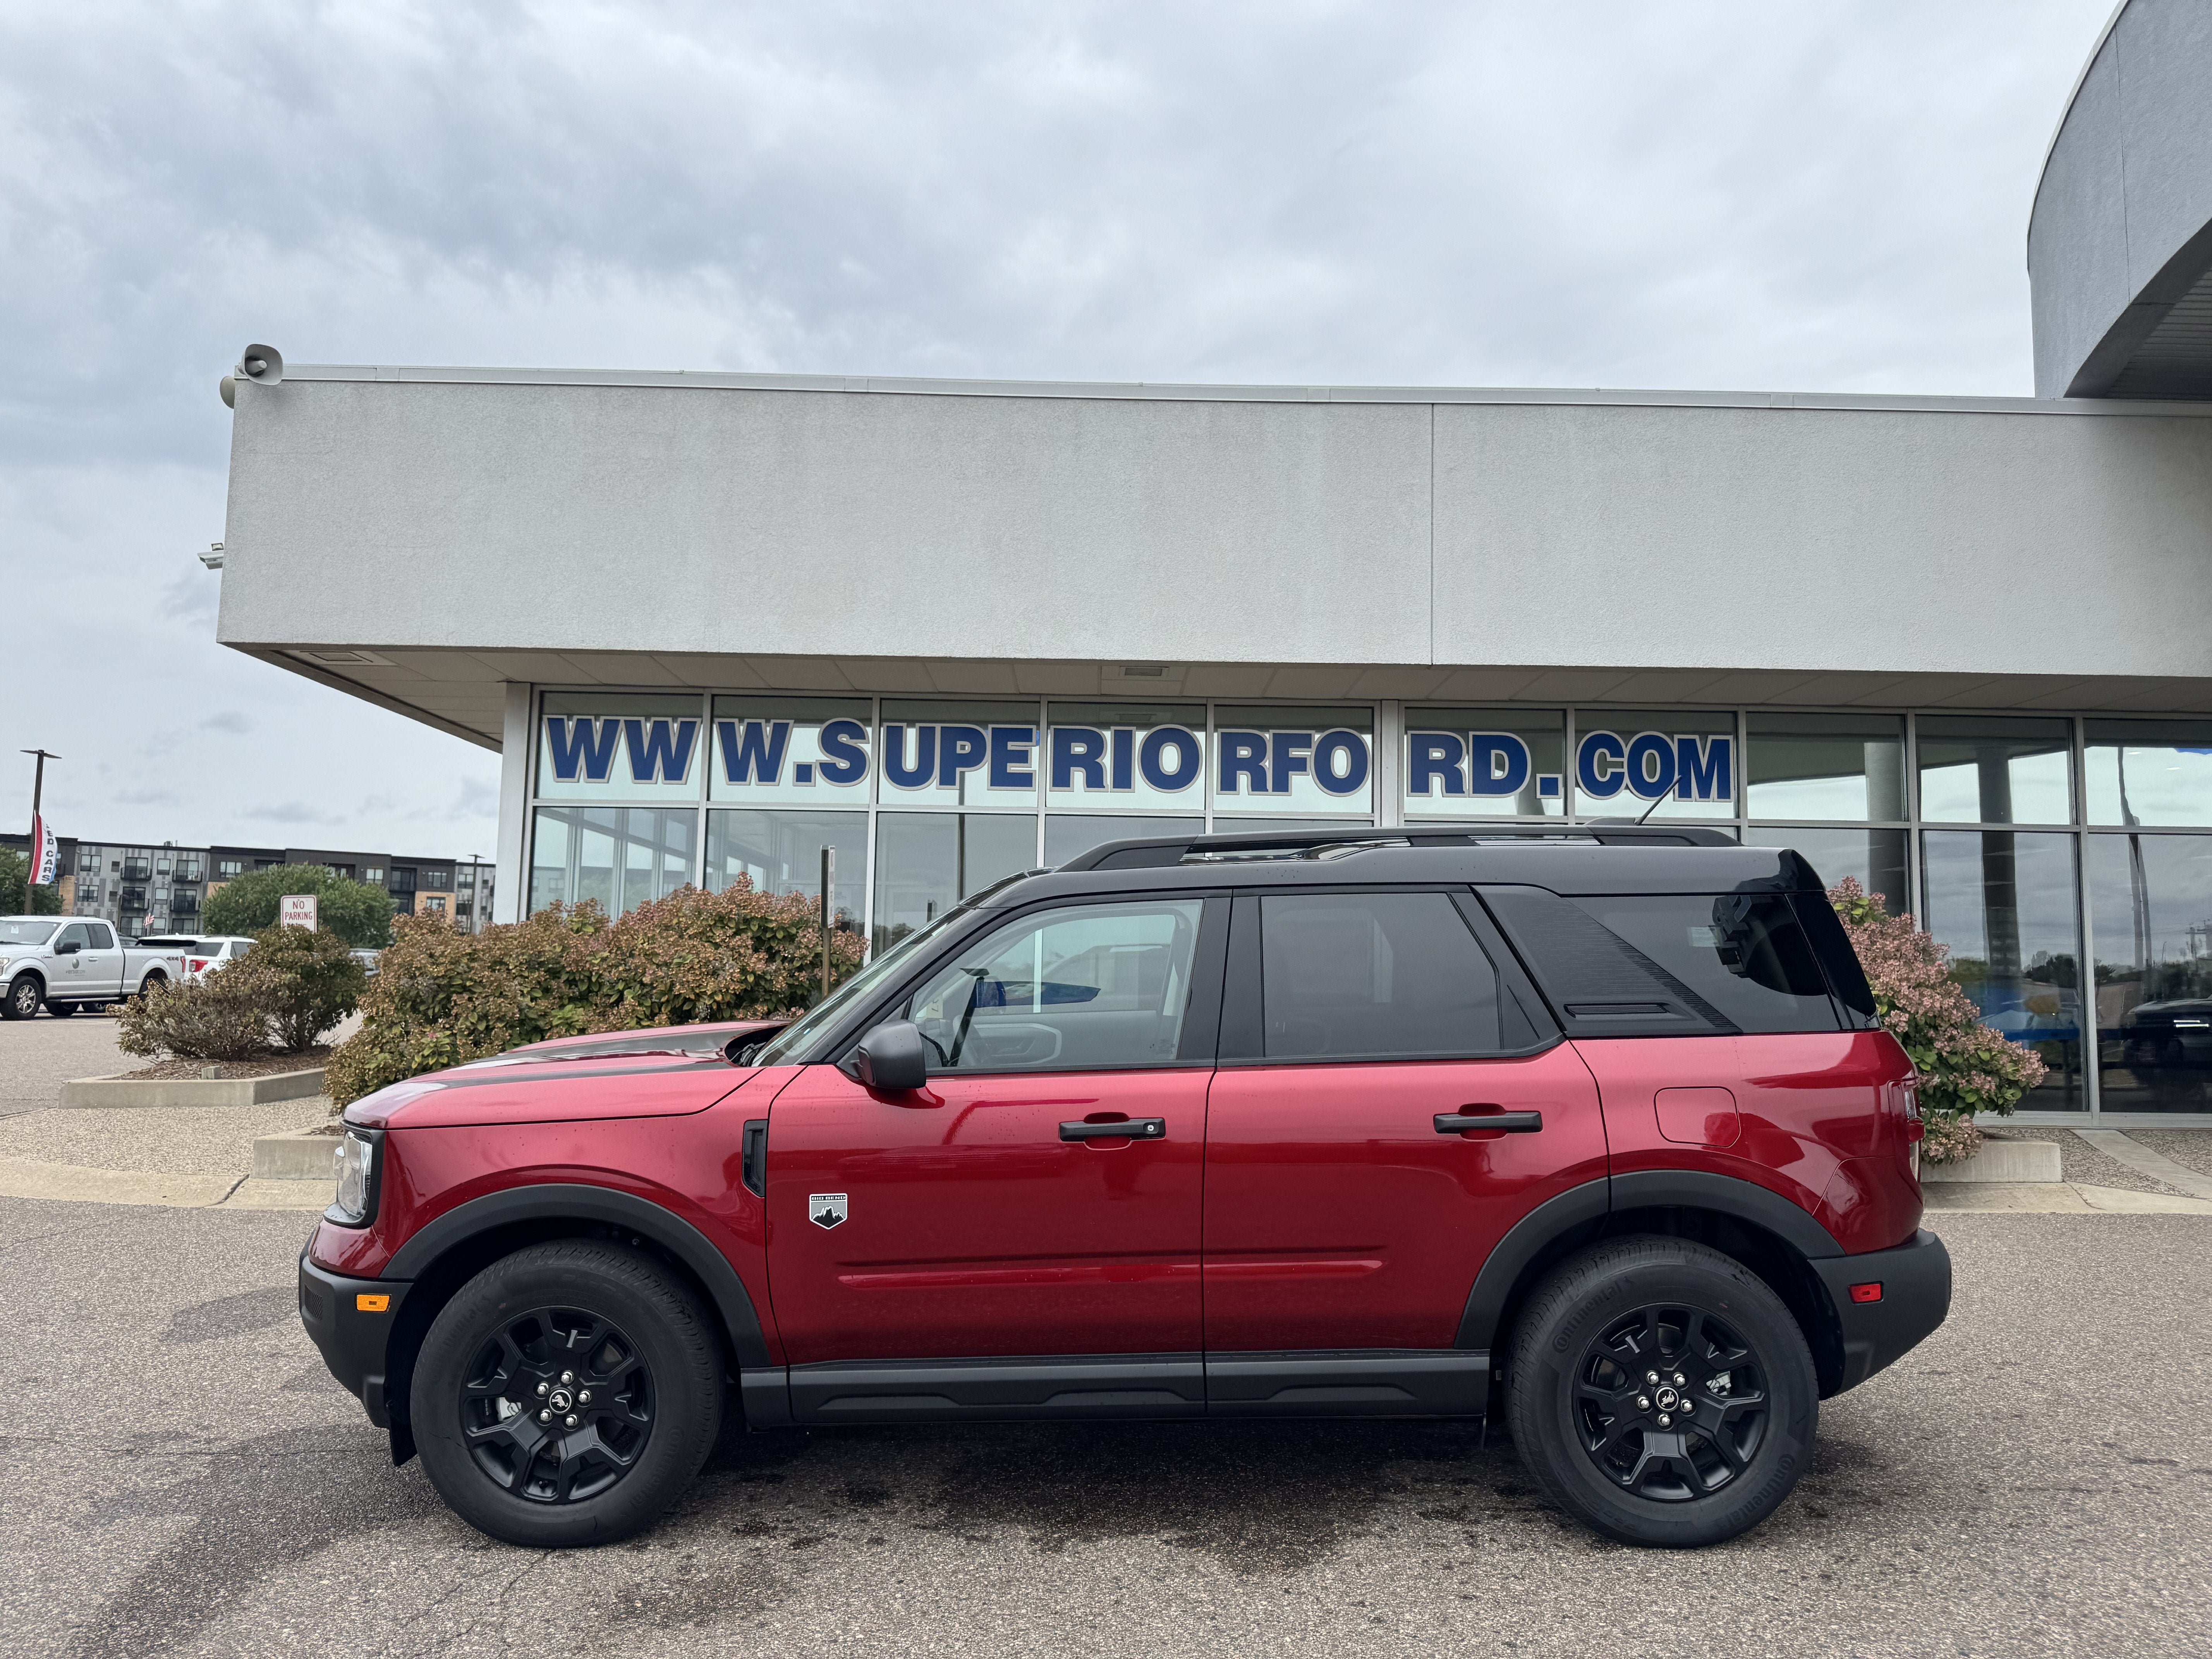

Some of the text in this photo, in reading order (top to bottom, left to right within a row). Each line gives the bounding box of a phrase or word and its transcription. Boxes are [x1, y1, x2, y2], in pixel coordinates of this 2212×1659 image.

[42, 850, 53, 881] CARS
[285, 911, 312, 920] PARKING
[293, 901, 304, 909] NO
[1552, 1280, 1621, 1353] Continental
[1725, 1454, 1795, 1527] Continental
